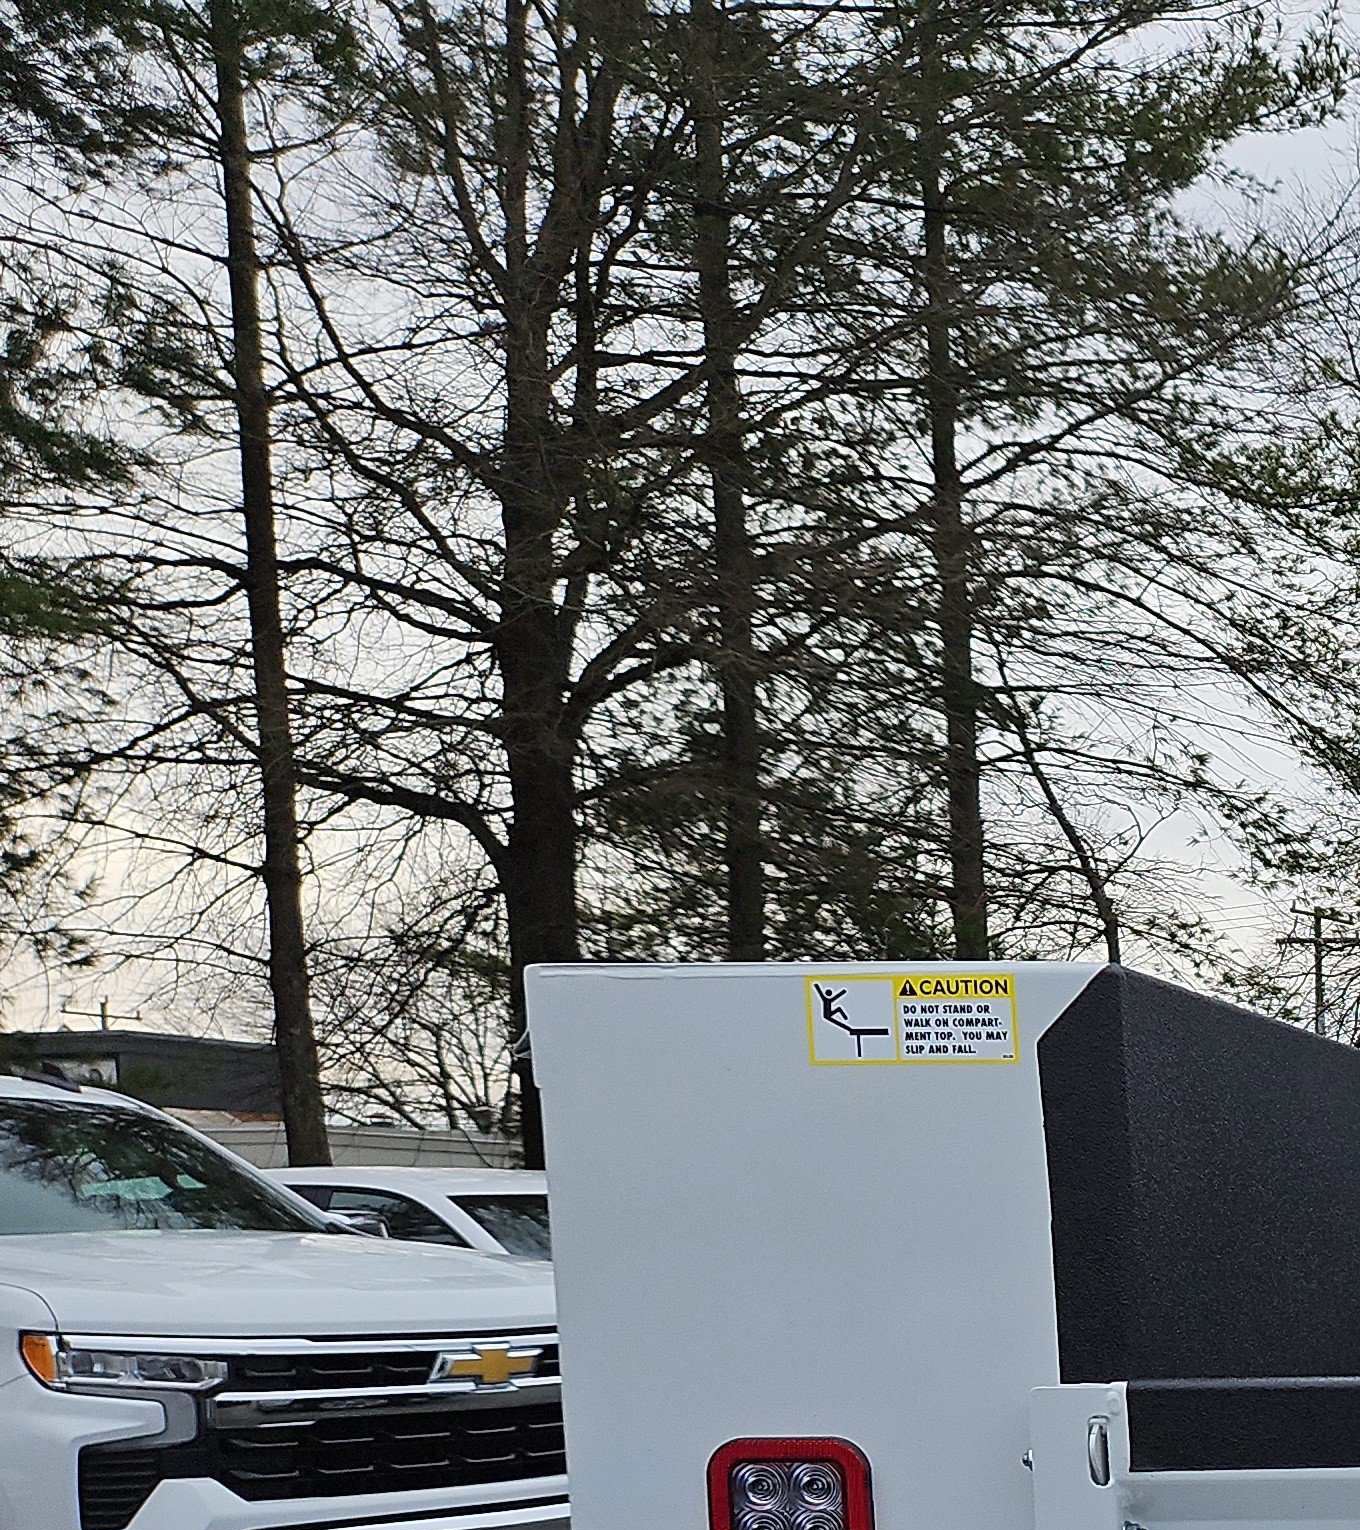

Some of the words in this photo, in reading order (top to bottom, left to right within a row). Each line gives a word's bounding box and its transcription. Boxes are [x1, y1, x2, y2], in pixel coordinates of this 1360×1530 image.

[919, 979, 1008, 995] CAUTION
[903, 1004, 916, 1014] DO
[921, 1004, 939, 1014] NOT
[943, 1004, 972, 1014] STAND
[977, 1004, 990, 1014] OR
[904, 1018, 932, 1027] WALK
[935, 1018, 949, 1027] ON
[953, 1018, 1002, 1027] COMPART-
[905, 1031, 931, 1041] MENT
[934, 1031, 955, 1041] TOP.
[962, 1031, 982, 1040] YOU
[986, 1031, 1008, 1040] MAY
[905, 1045, 925, 1054] SLIP
[929, 1045, 948, 1054] AND
[952, 1044, 976, 1054] FALL.
